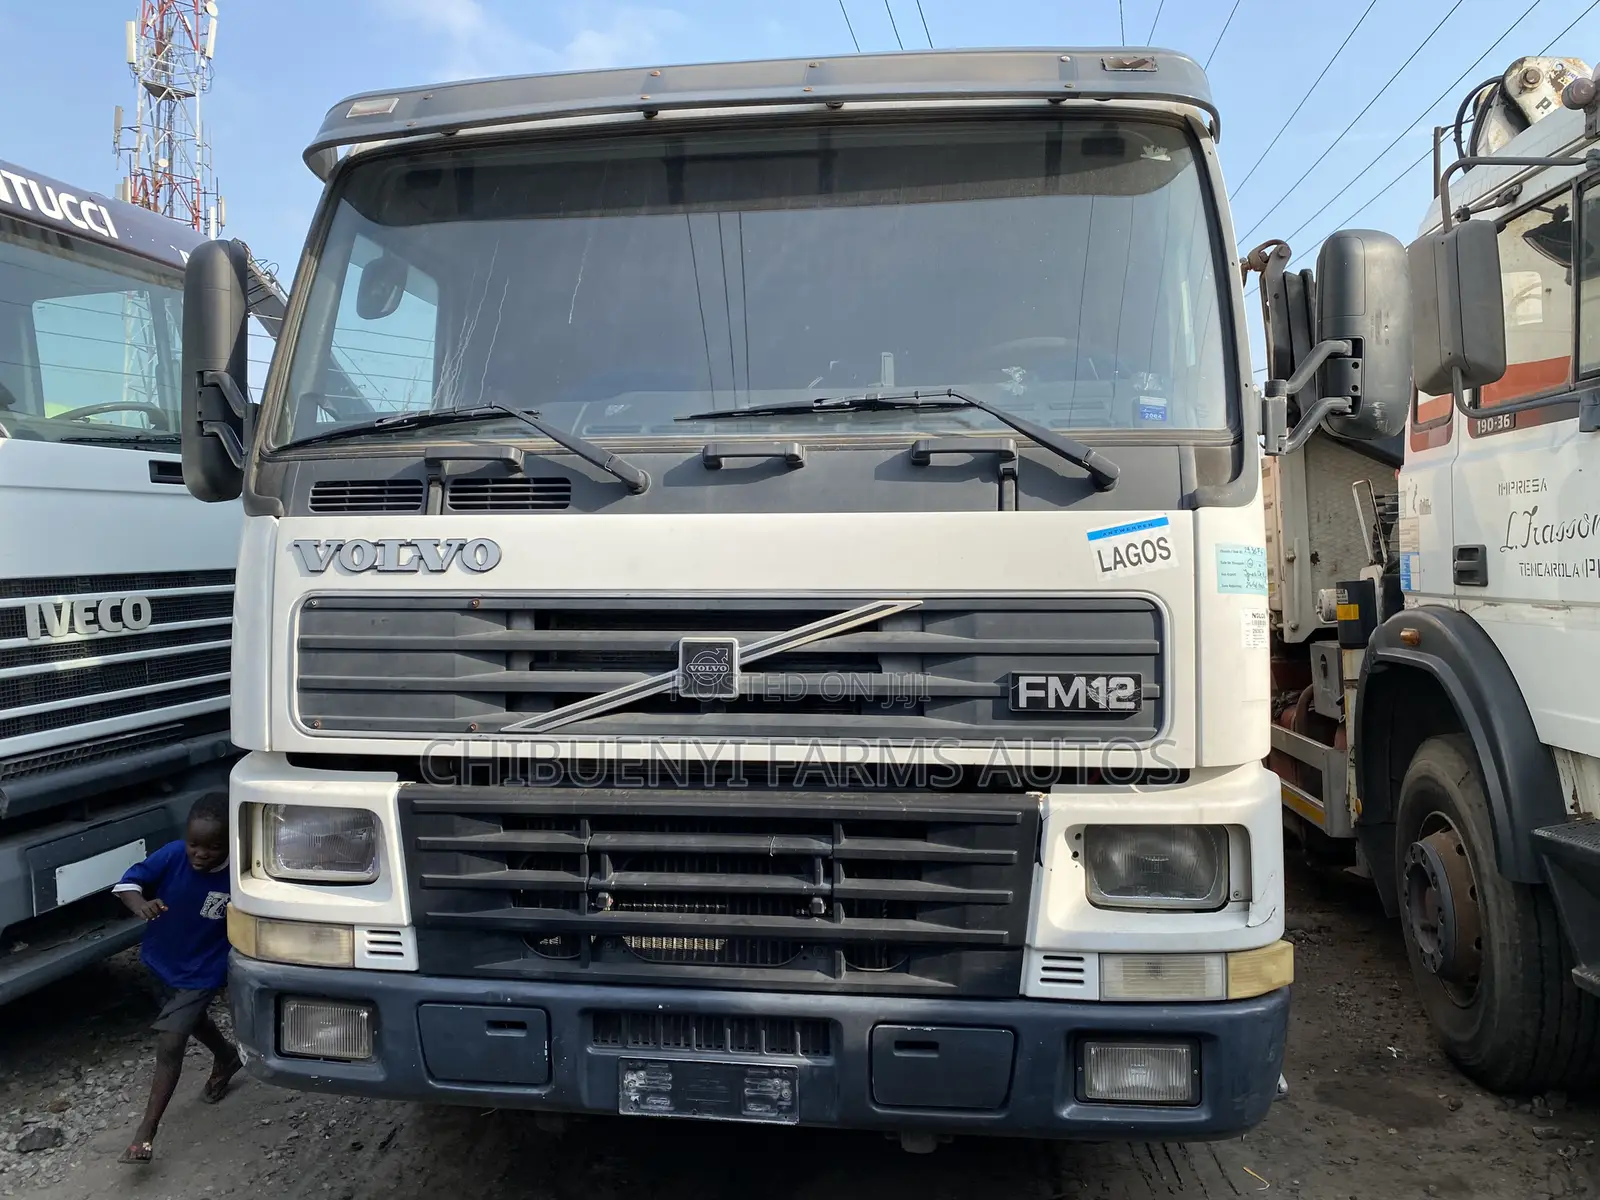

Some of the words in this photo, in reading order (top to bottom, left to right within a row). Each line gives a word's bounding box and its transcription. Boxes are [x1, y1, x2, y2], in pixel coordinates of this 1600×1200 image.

[293, 537, 502, 573] VOLVO
[1097, 536, 1171, 572] LAGOS
[24, 595, 152, 640] IVECO
[1018, 676, 1136, 709] FM12
